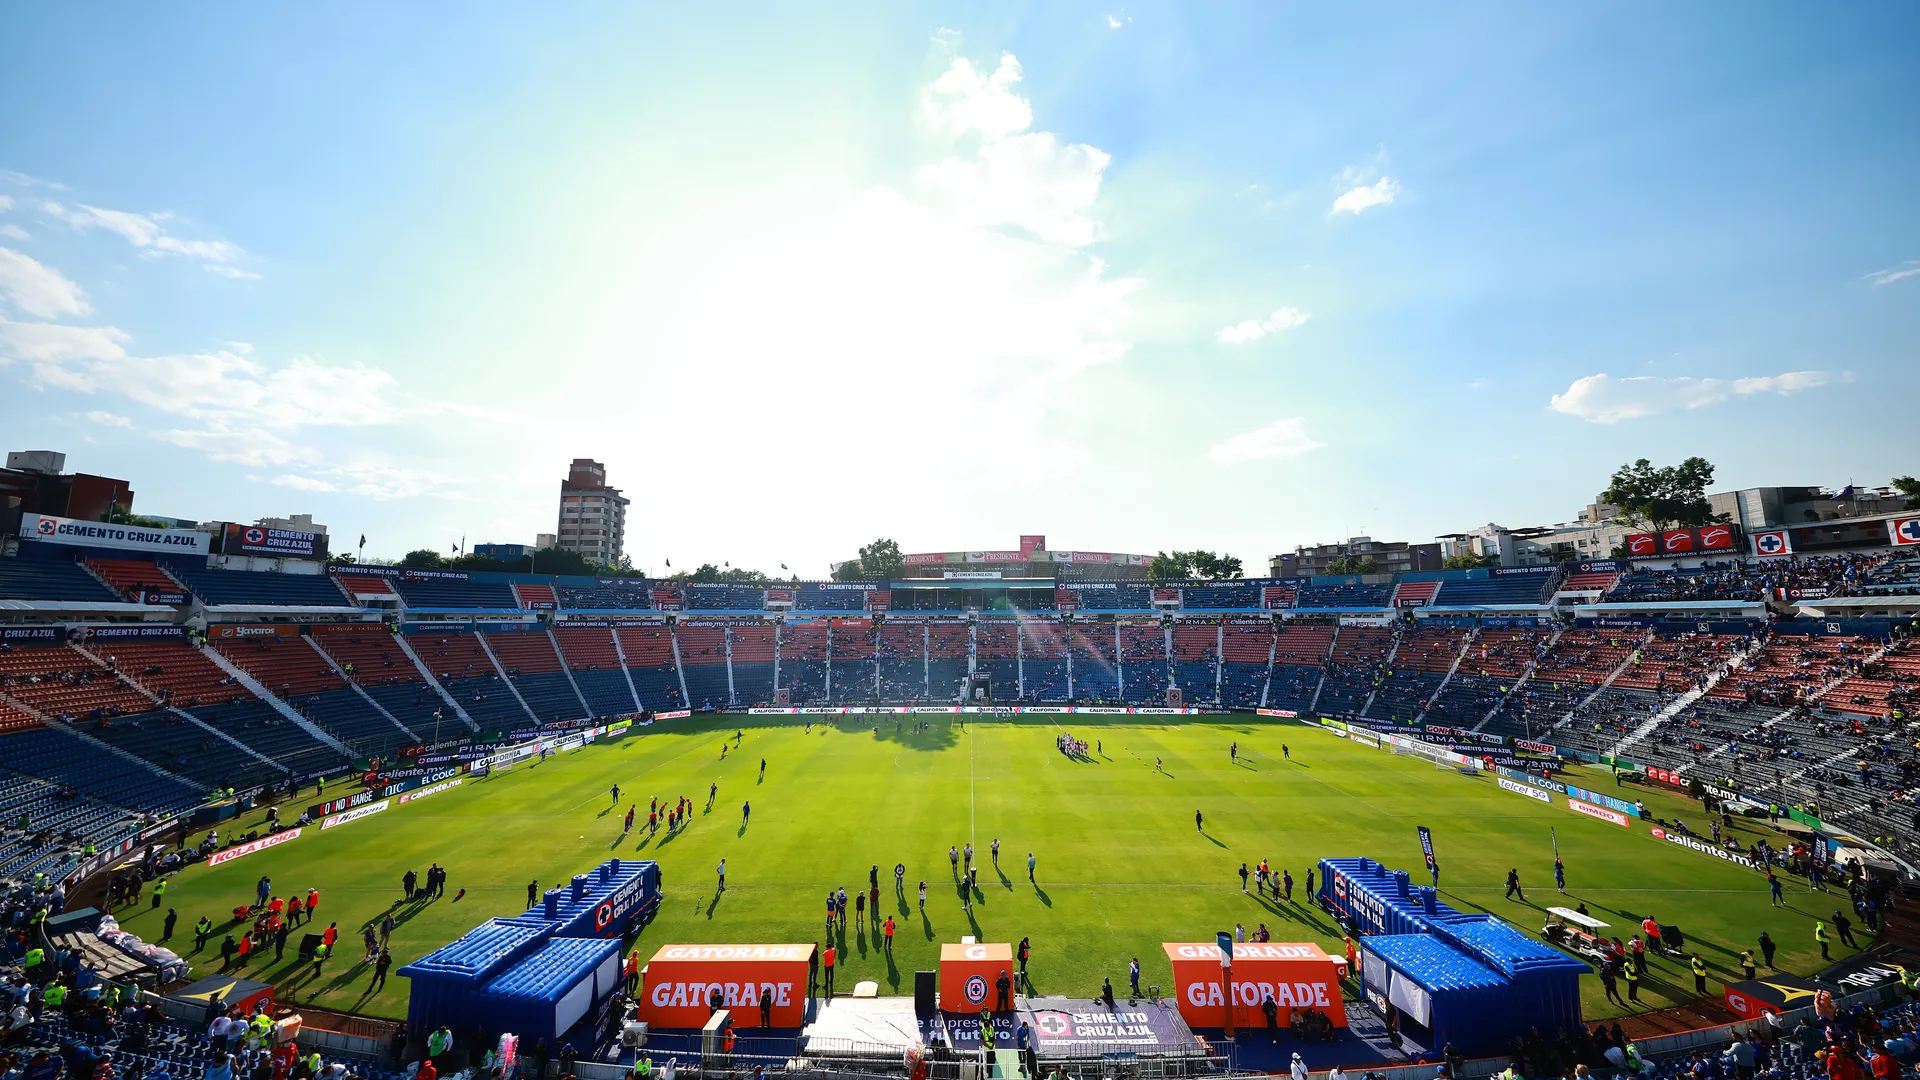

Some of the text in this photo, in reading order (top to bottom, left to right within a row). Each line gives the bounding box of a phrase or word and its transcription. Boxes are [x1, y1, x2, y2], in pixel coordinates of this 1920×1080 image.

[58, 524, 197, 546] CEMENTO CRUZ AZUL
[268, 529, 314, 541] CEMENTO
[267, 538, 313, 549] CRUZ AZUL
[986, 552, 1021, 561] PRESIDENTE
[1073, 552, 1103, 561] PRESIDENTE
[1699, 548, 1737, 556] caliente.mx
[906, 554, 936, 563] PRESIDENTE
[687, 620, 724, 628] caliente.mx
[4, 629, 55, 638] CRUZ AZUL
[1352, 726, 1381, 739] CALIFORNIA
[1412, 733, 1457, 743] PIRMA
[1427, 725, 1500, 744] GONHER One
[425, 737, 472, 752] caliente.mx
[553, 733, 585, 746] CALIFORNIA
[459, 742, 507, 753] PIRMA
[533, 743, 544, 752] RC
[1410, 742, 1448, 758] CALIFORNIA
[1455, 744, 1482, 752] CEMENTO
[1515, 739, 1555, 754] GONHER
[480, 750, 521, 767] CALIFORNIA
[1462, 755, 1475, 766] RC
[421, 775, 430, 785] EL
[1527, 775, 1536, 784] EL
[410, 778, 463, 801] caliente.mx
[1499, 779, 1546, 799] telcel 5G
[319, 790, 373, 816] GO AND CHANGE
[1577, 788, 1629, 814] GO AND CHANGE
[1578, 804, 1615, 820] BIMBO
[214, 831, 297, 863] KOLA LOKA
[663, 946, 802, 958] GATORADE
[1337, 966, 1345, 975] G
[651, 982, 793, 1007] GATORADE
[929, 1019, 942, 1027] tu
[1073, 1012, 1149, 1024] CEMENTO
[929, 1029, 1015, 1041] tu futro.
[1075, 1025, 1155, 1037] CRUZ AZUL
